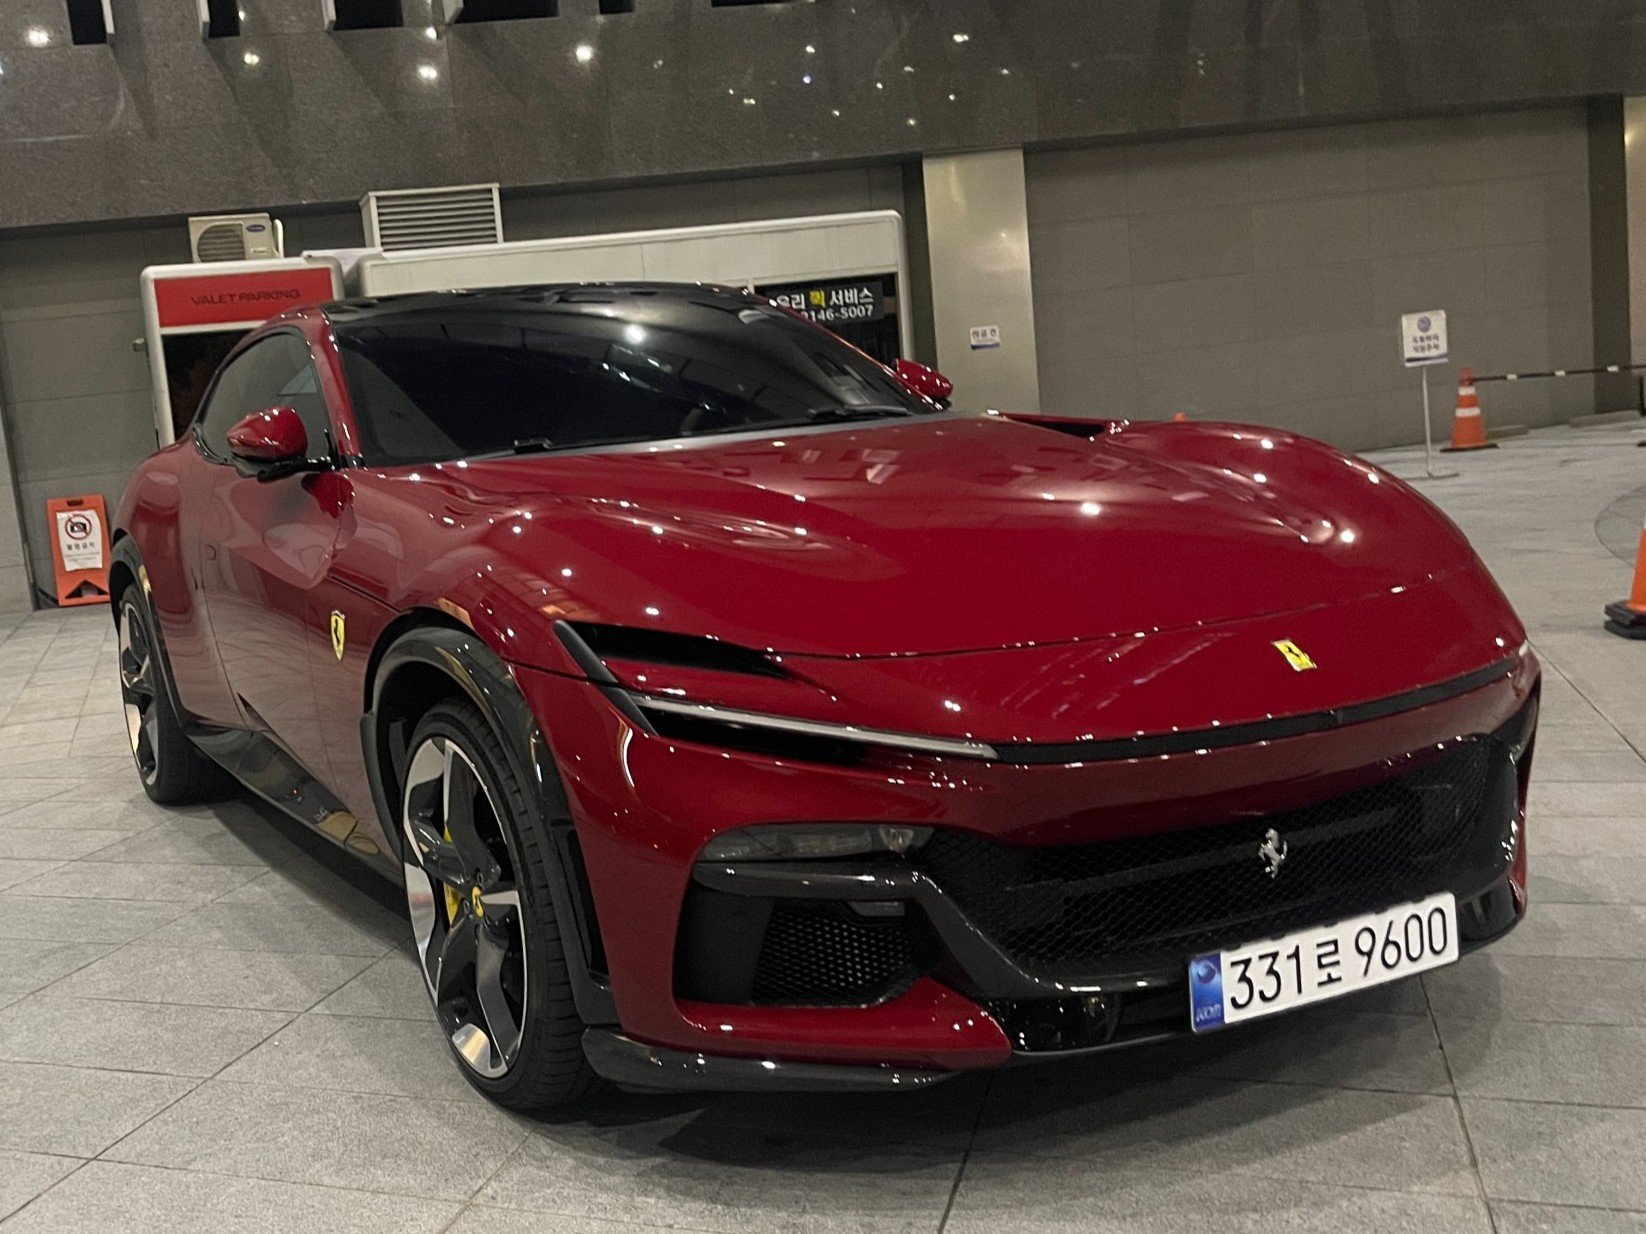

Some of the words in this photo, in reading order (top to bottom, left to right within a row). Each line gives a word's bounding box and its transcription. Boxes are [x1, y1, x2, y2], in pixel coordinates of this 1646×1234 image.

[191, 293, 238, 305] VALET
[239, 288, 300, 301] PARKING
[830, 287, 874, 306] 서비스
